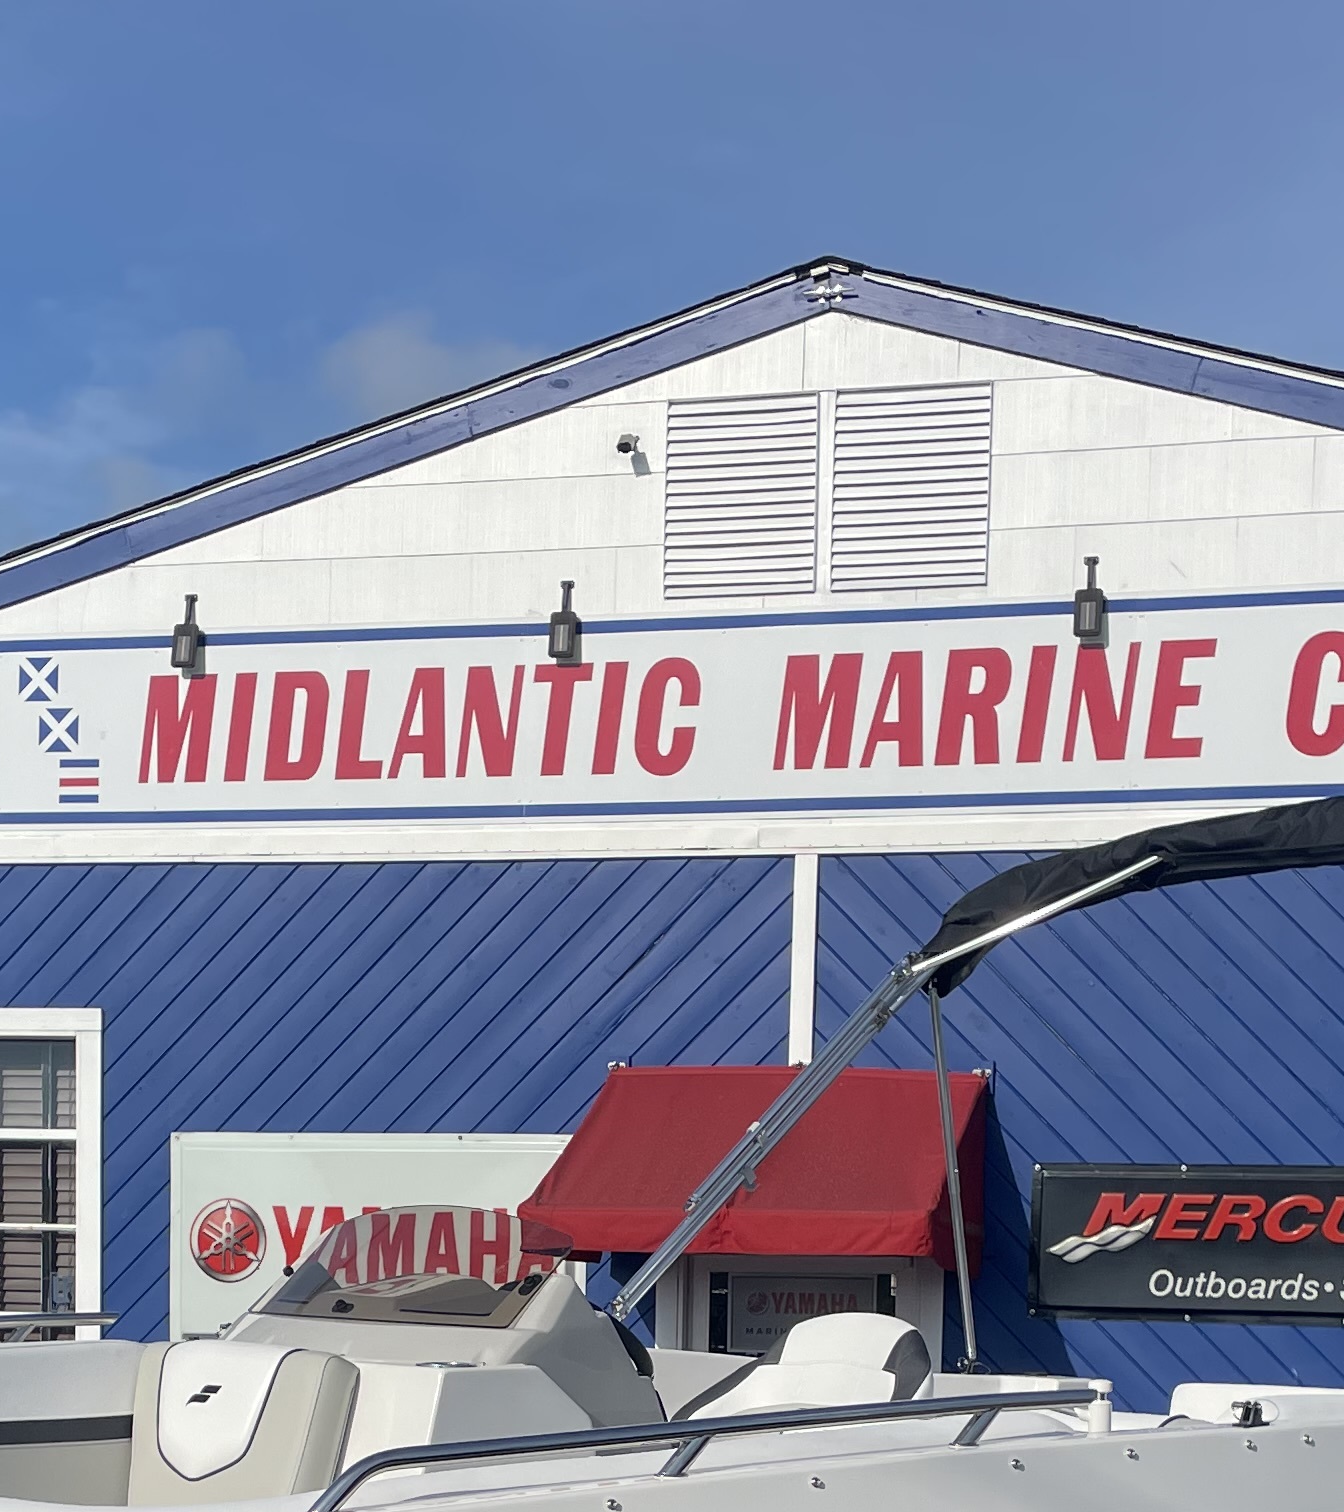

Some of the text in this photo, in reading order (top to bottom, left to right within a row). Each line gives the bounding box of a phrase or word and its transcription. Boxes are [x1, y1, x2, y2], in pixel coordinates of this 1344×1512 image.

[139, 658, 701, 783] MIDLANTIC
[773, 639, 1216, 770] MARINE
[771, 1292, 857, 1315] YAMAHA
